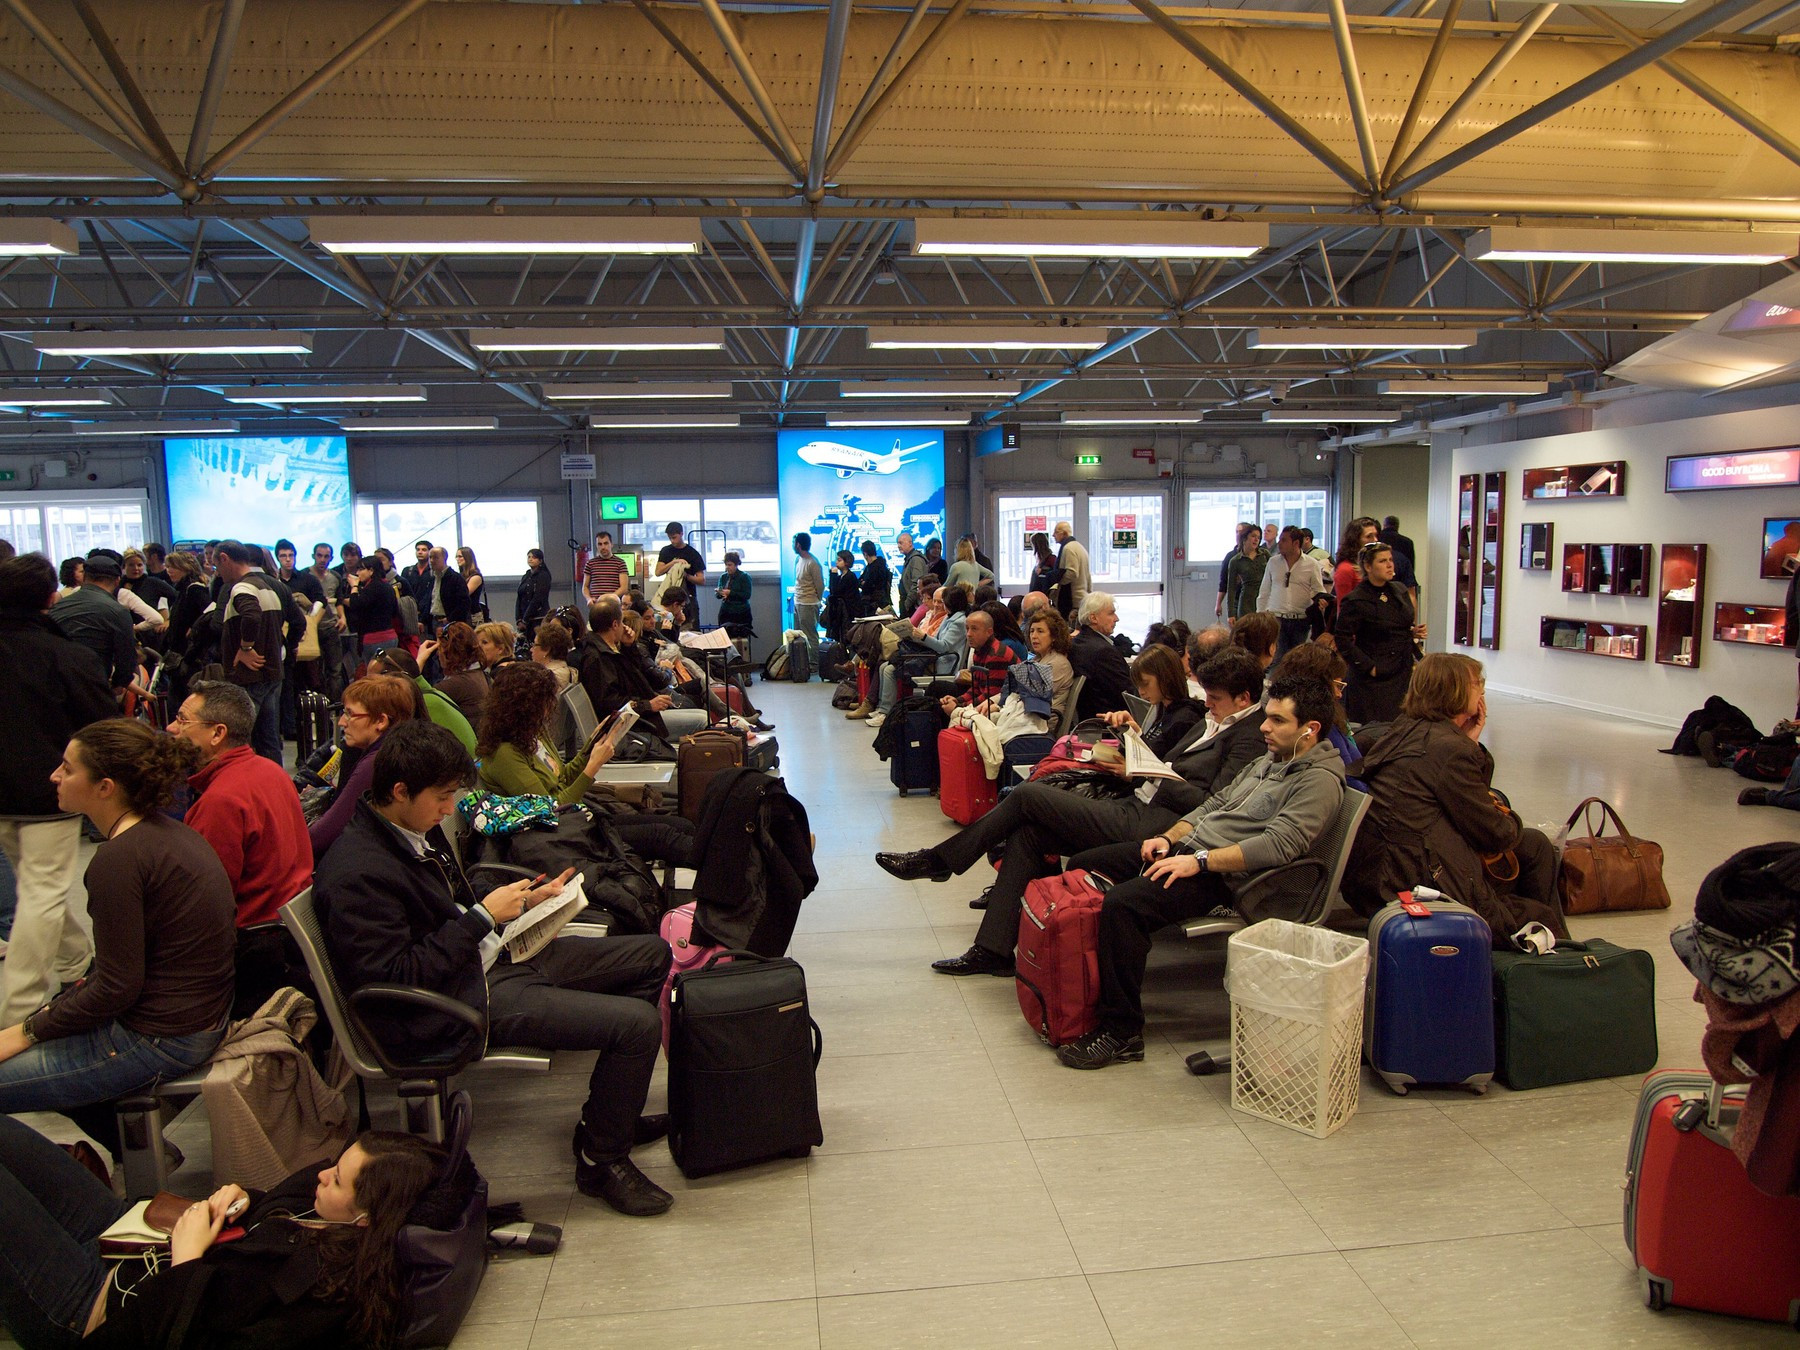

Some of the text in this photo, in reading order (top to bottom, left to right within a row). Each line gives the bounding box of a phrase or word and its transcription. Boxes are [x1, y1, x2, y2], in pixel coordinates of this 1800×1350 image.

[831, 447, 865, 458] RYANAIR
[1702, 466, 1724, 477] GOOD
[1725, 465, 1743, 476] BUY
